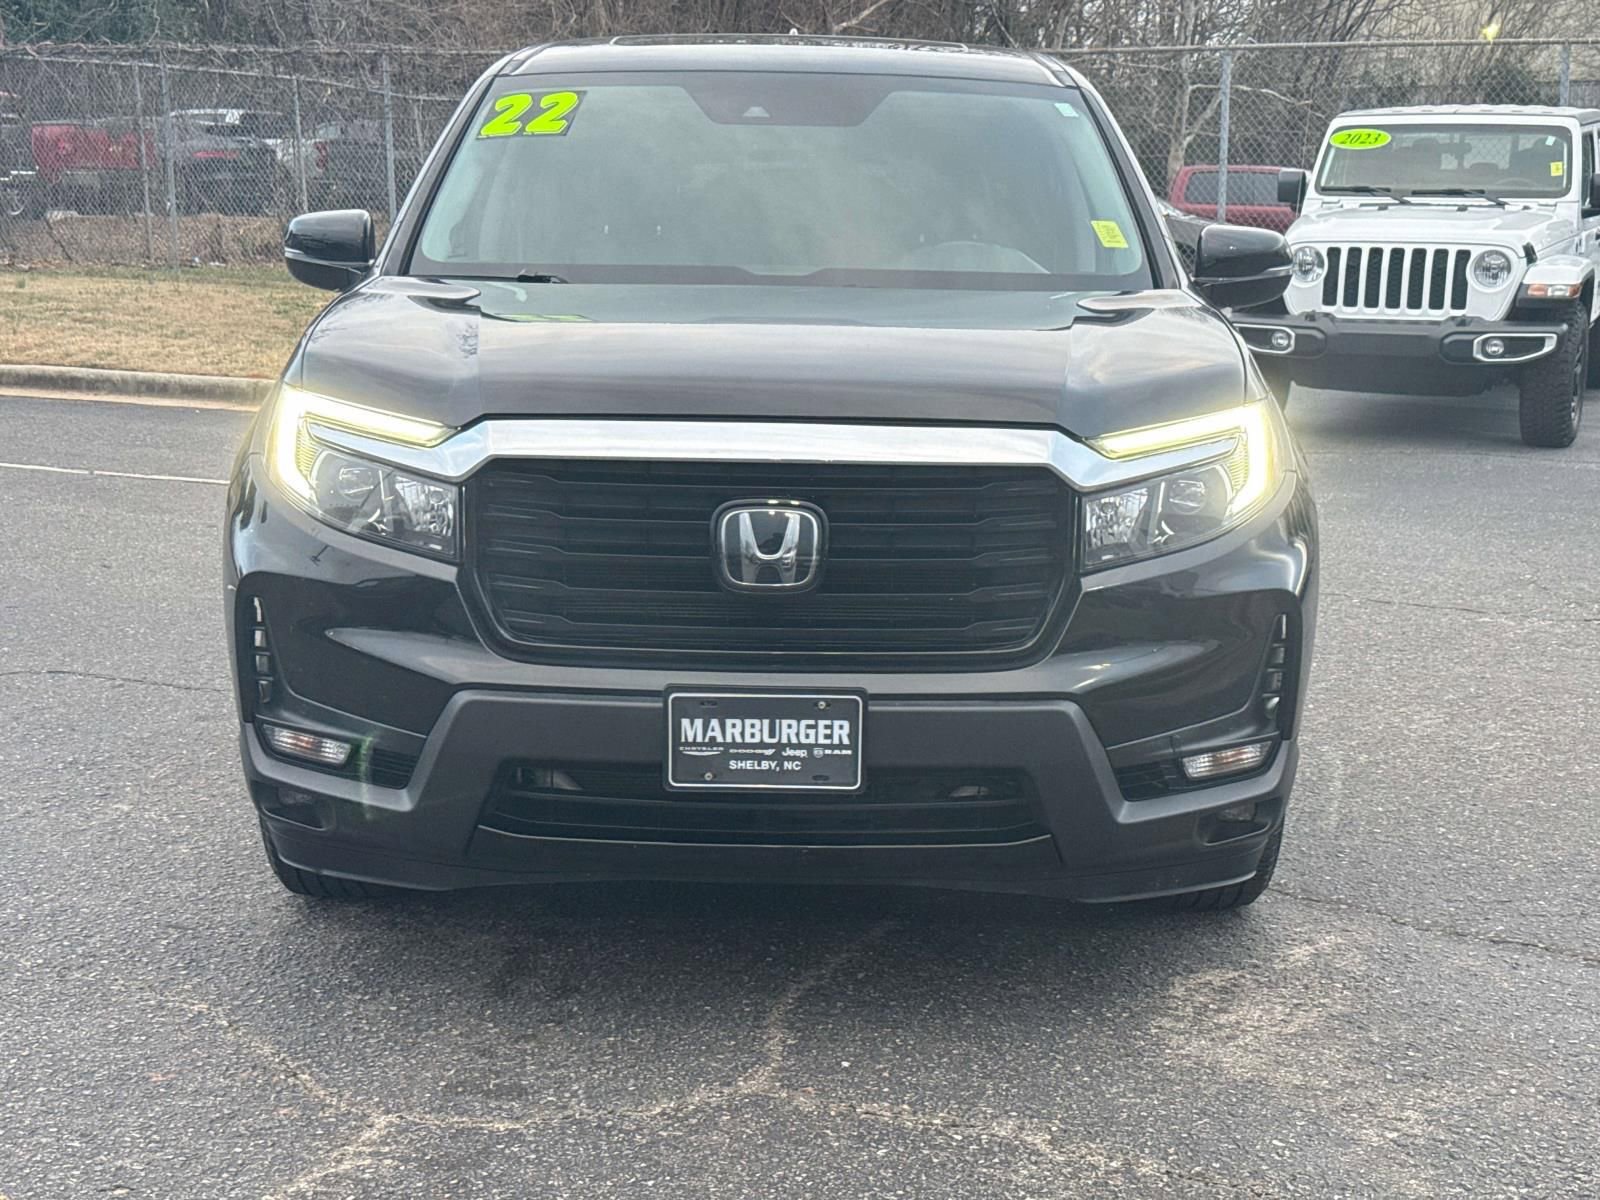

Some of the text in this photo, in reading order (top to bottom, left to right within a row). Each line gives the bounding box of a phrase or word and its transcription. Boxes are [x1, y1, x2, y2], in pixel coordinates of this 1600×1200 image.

[480, 92, 579, 136] 22
[1339, 133, 1382, 145] 2023
[680, 718, 850, 745] MARBURGER
[781, 747, 808, 758] Jeep
[729, 760, 802, 772] SHELBY, NC
